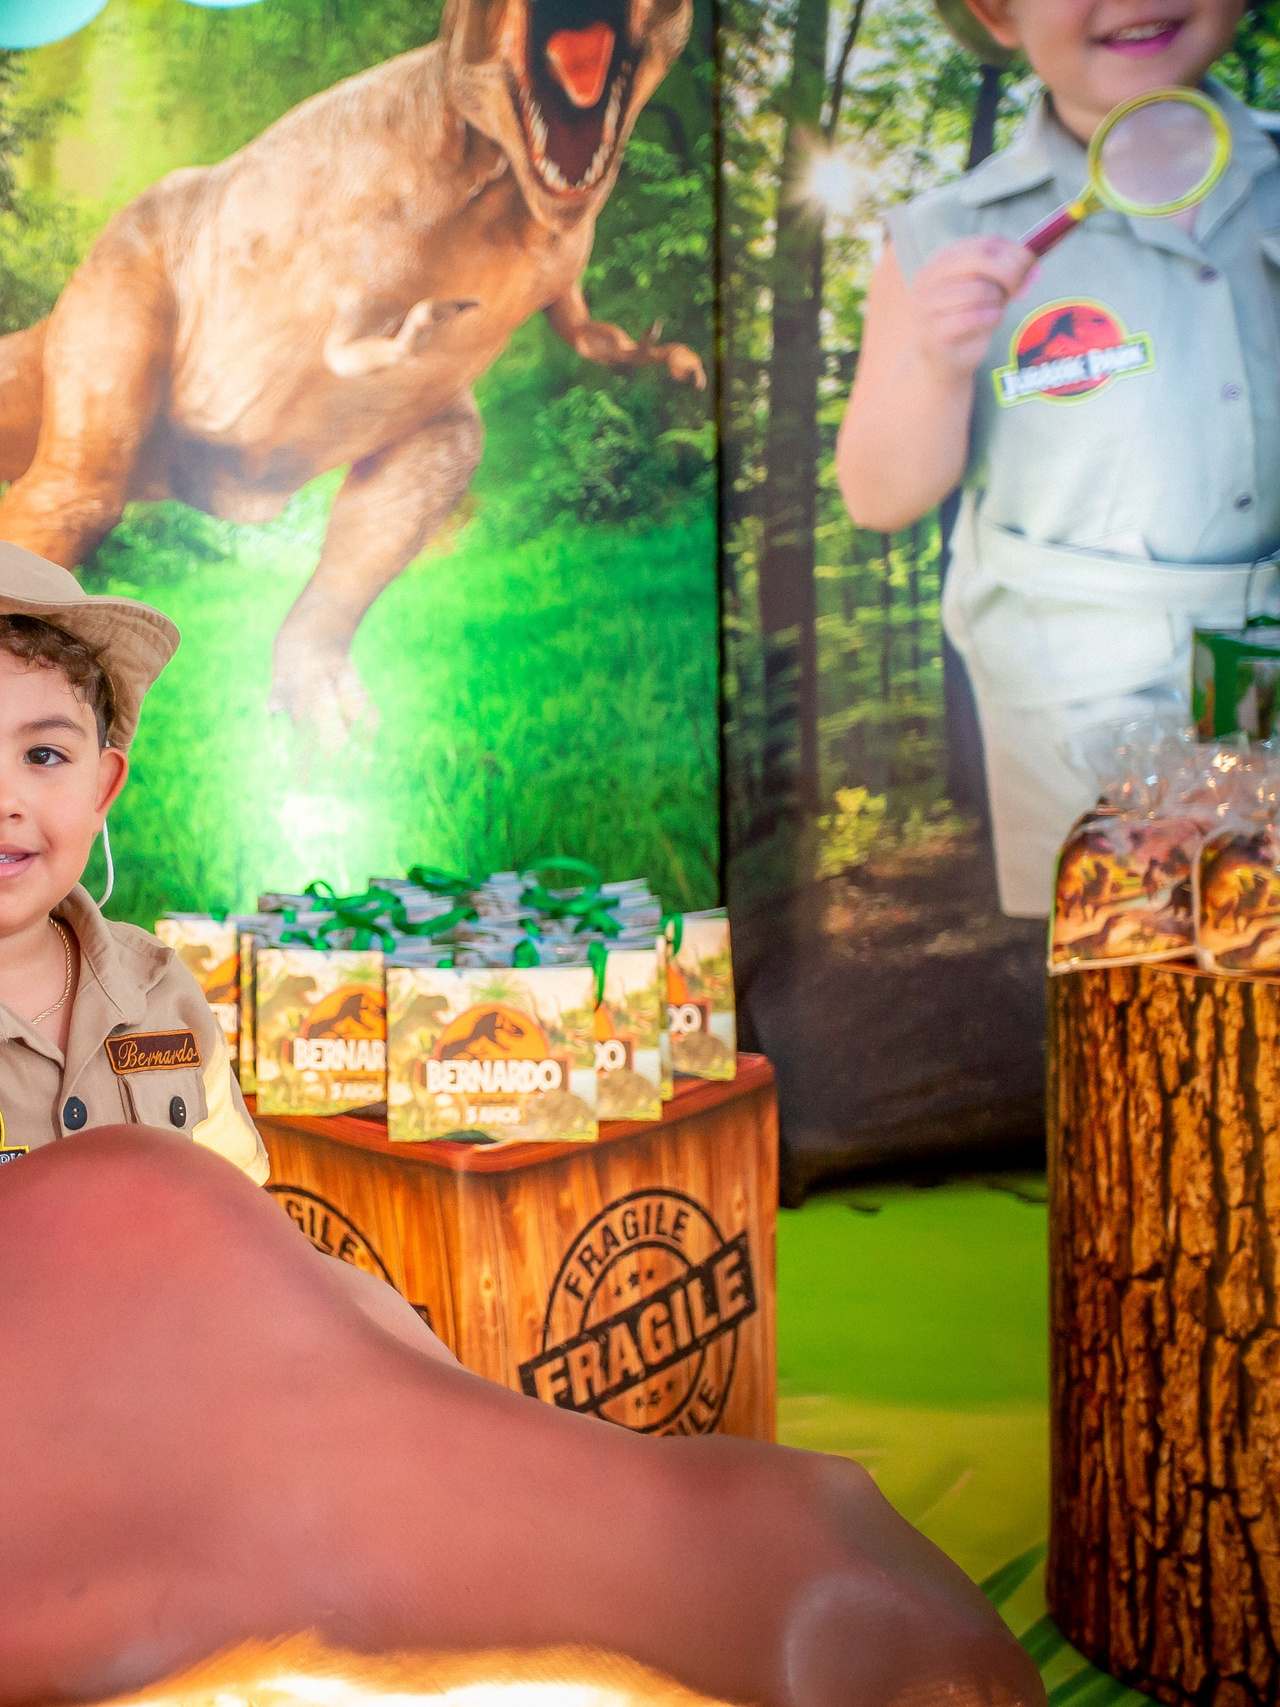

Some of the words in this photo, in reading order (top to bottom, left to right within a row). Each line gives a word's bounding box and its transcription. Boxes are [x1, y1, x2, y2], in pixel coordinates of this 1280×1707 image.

[120, 1038, 198, 1068] Bernardo
[426, 1059, 562, 1093] BERNARDO
[563, 1202, 689, 1300] FRAGILE
[534, 1250, 749, 1406] FRAGILE
